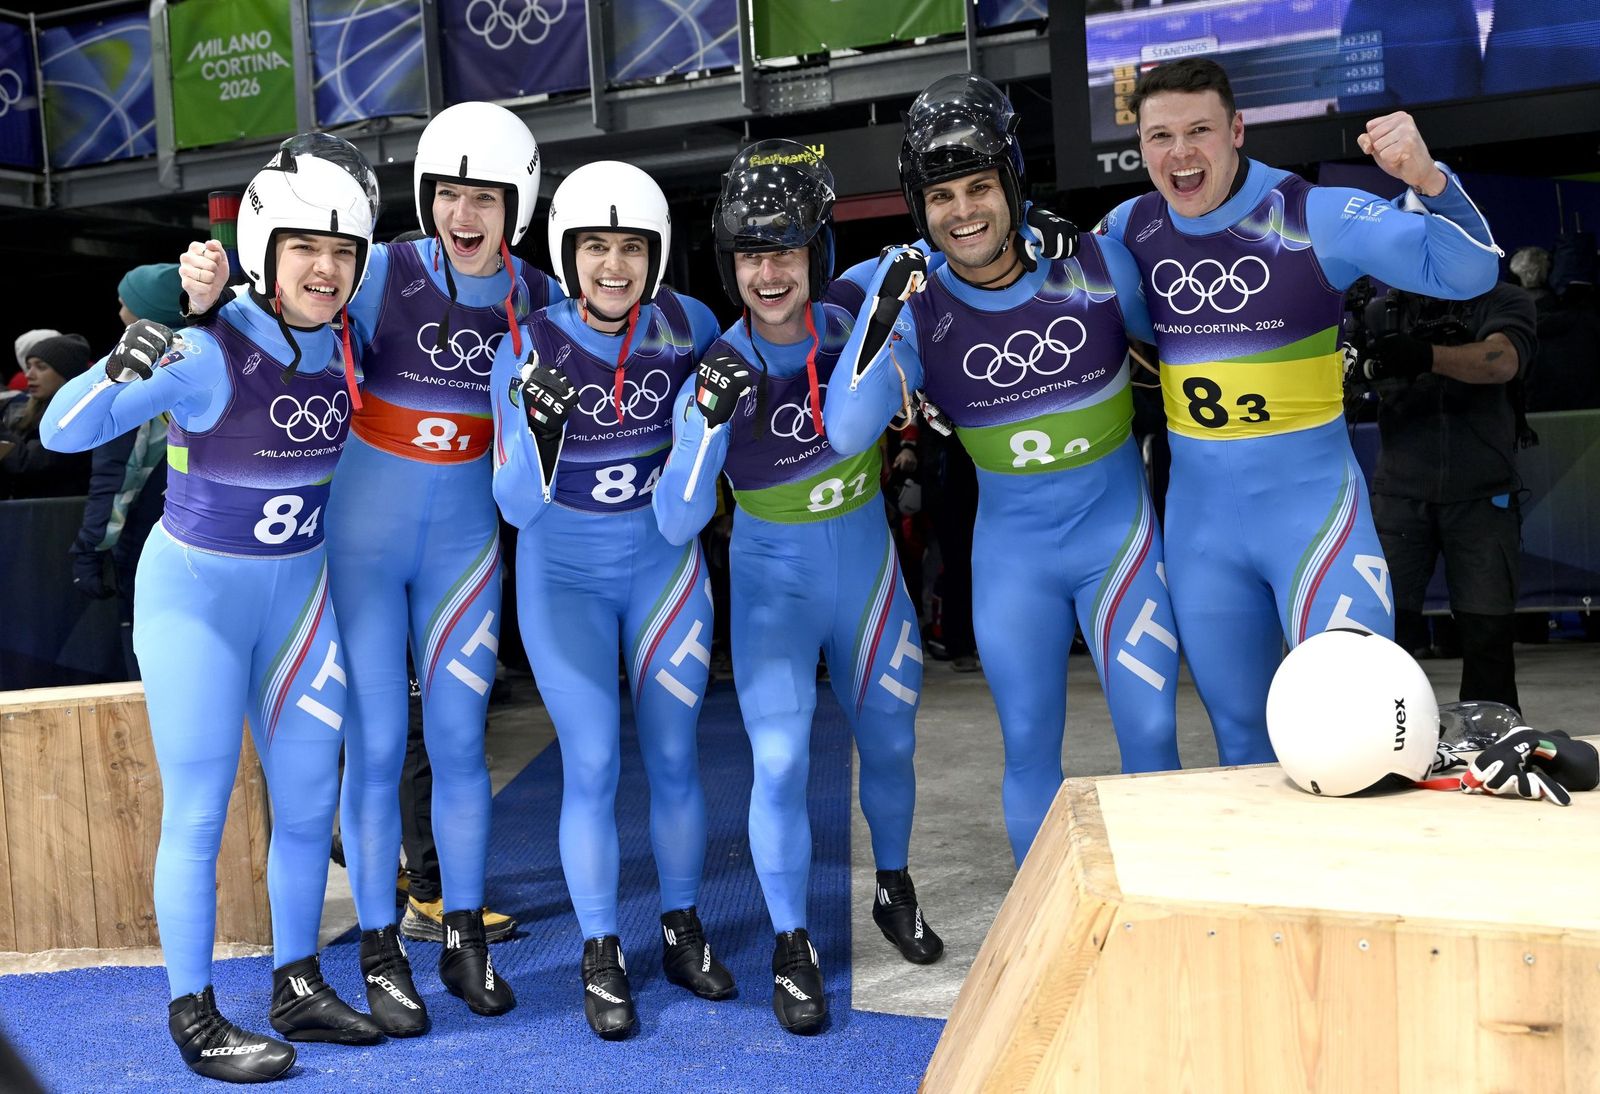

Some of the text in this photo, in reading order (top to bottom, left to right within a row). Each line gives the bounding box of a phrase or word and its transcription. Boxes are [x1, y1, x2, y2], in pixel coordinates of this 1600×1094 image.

[187, 30, 272, 63] MILANO
[1152, 42, 1208, 58] STANDINGS
[201, 51, 291, 80] CORTINA
[219, 77, 261, 101] 2026
[1096, 149, 1146, 173] TC
[248, 182, 264, 216] uvex
[1153, 318, 1285, 334] MILANO CORTINA 2026
[396, 371, 447, 386] MILANO
[966, 367, 1106, 408] MILANO CORTINA 2026
[567, 432, 615, 442] MILANO
[616, 423, 662, 438] CORTINA
[253, 449, 302, 458] MILANO
[303, 446, 337, 457] CORTINA
[774, 445, 821, 466] MILANO
[1324, 553, 1392, 635] TA
[445, 609, 499, 697] IT
[1116, 597, 1179, 692] IT
[655, 618, 712, 709] IT
[878, 619, 924, 707] IT
[295, 640, 347, 732] IT
[1393, 697, 1407, 752] uvex
[200, 1042, 269, 1057] SKECHERS
